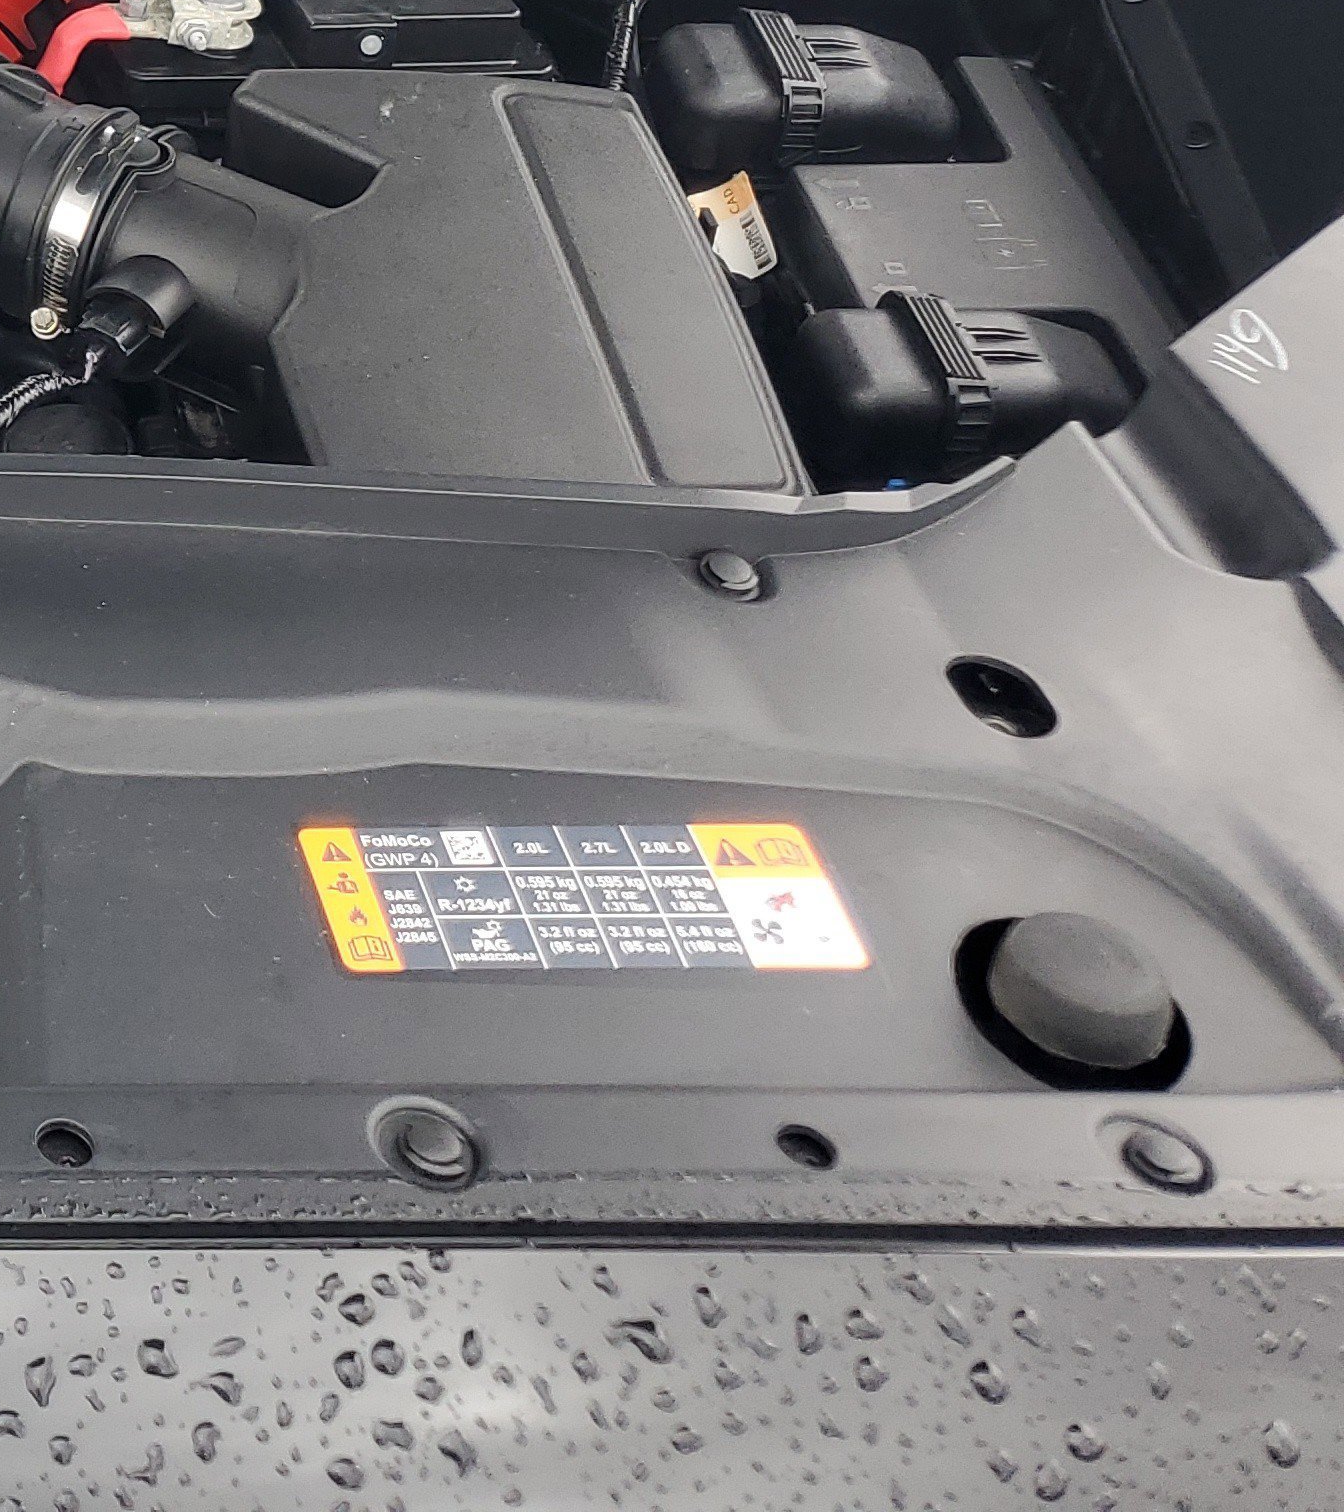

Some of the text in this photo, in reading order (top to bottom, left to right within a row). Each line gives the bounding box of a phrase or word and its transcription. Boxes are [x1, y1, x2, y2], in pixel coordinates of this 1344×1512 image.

[723, 188, 740, 214] CAD
[360, 834, 433, 848] FoMoCo
[513, 841, 550, 855] 2.0L
[581, 841, 618, 855] 2.7L
[640, 841, 692, 855] 2.0L D
[364, 852, 439, 869] (GWP 4)
[515, 875, 578, 891] 0.595 kg
[623, 875, 647, 891] kg
[691, 875, 715, 891] kg
[383, 889, 417, 901] SAE
[534, 889, 571, 901] 21 oz
[602, 889, 639, 901] 21 oz
[437, 898, 512, 914] R-1234yf
[537, 925, 563, 938] 3.2
[577, 927, 599, 938] oz
[607, 925, 633, 938] 3.2
[646, 927, 669, 938] oz
[471, 938, 512, 952] PAG
[575, 940, 601, 955] cc)
[645, 940, 671, 955] cc)
